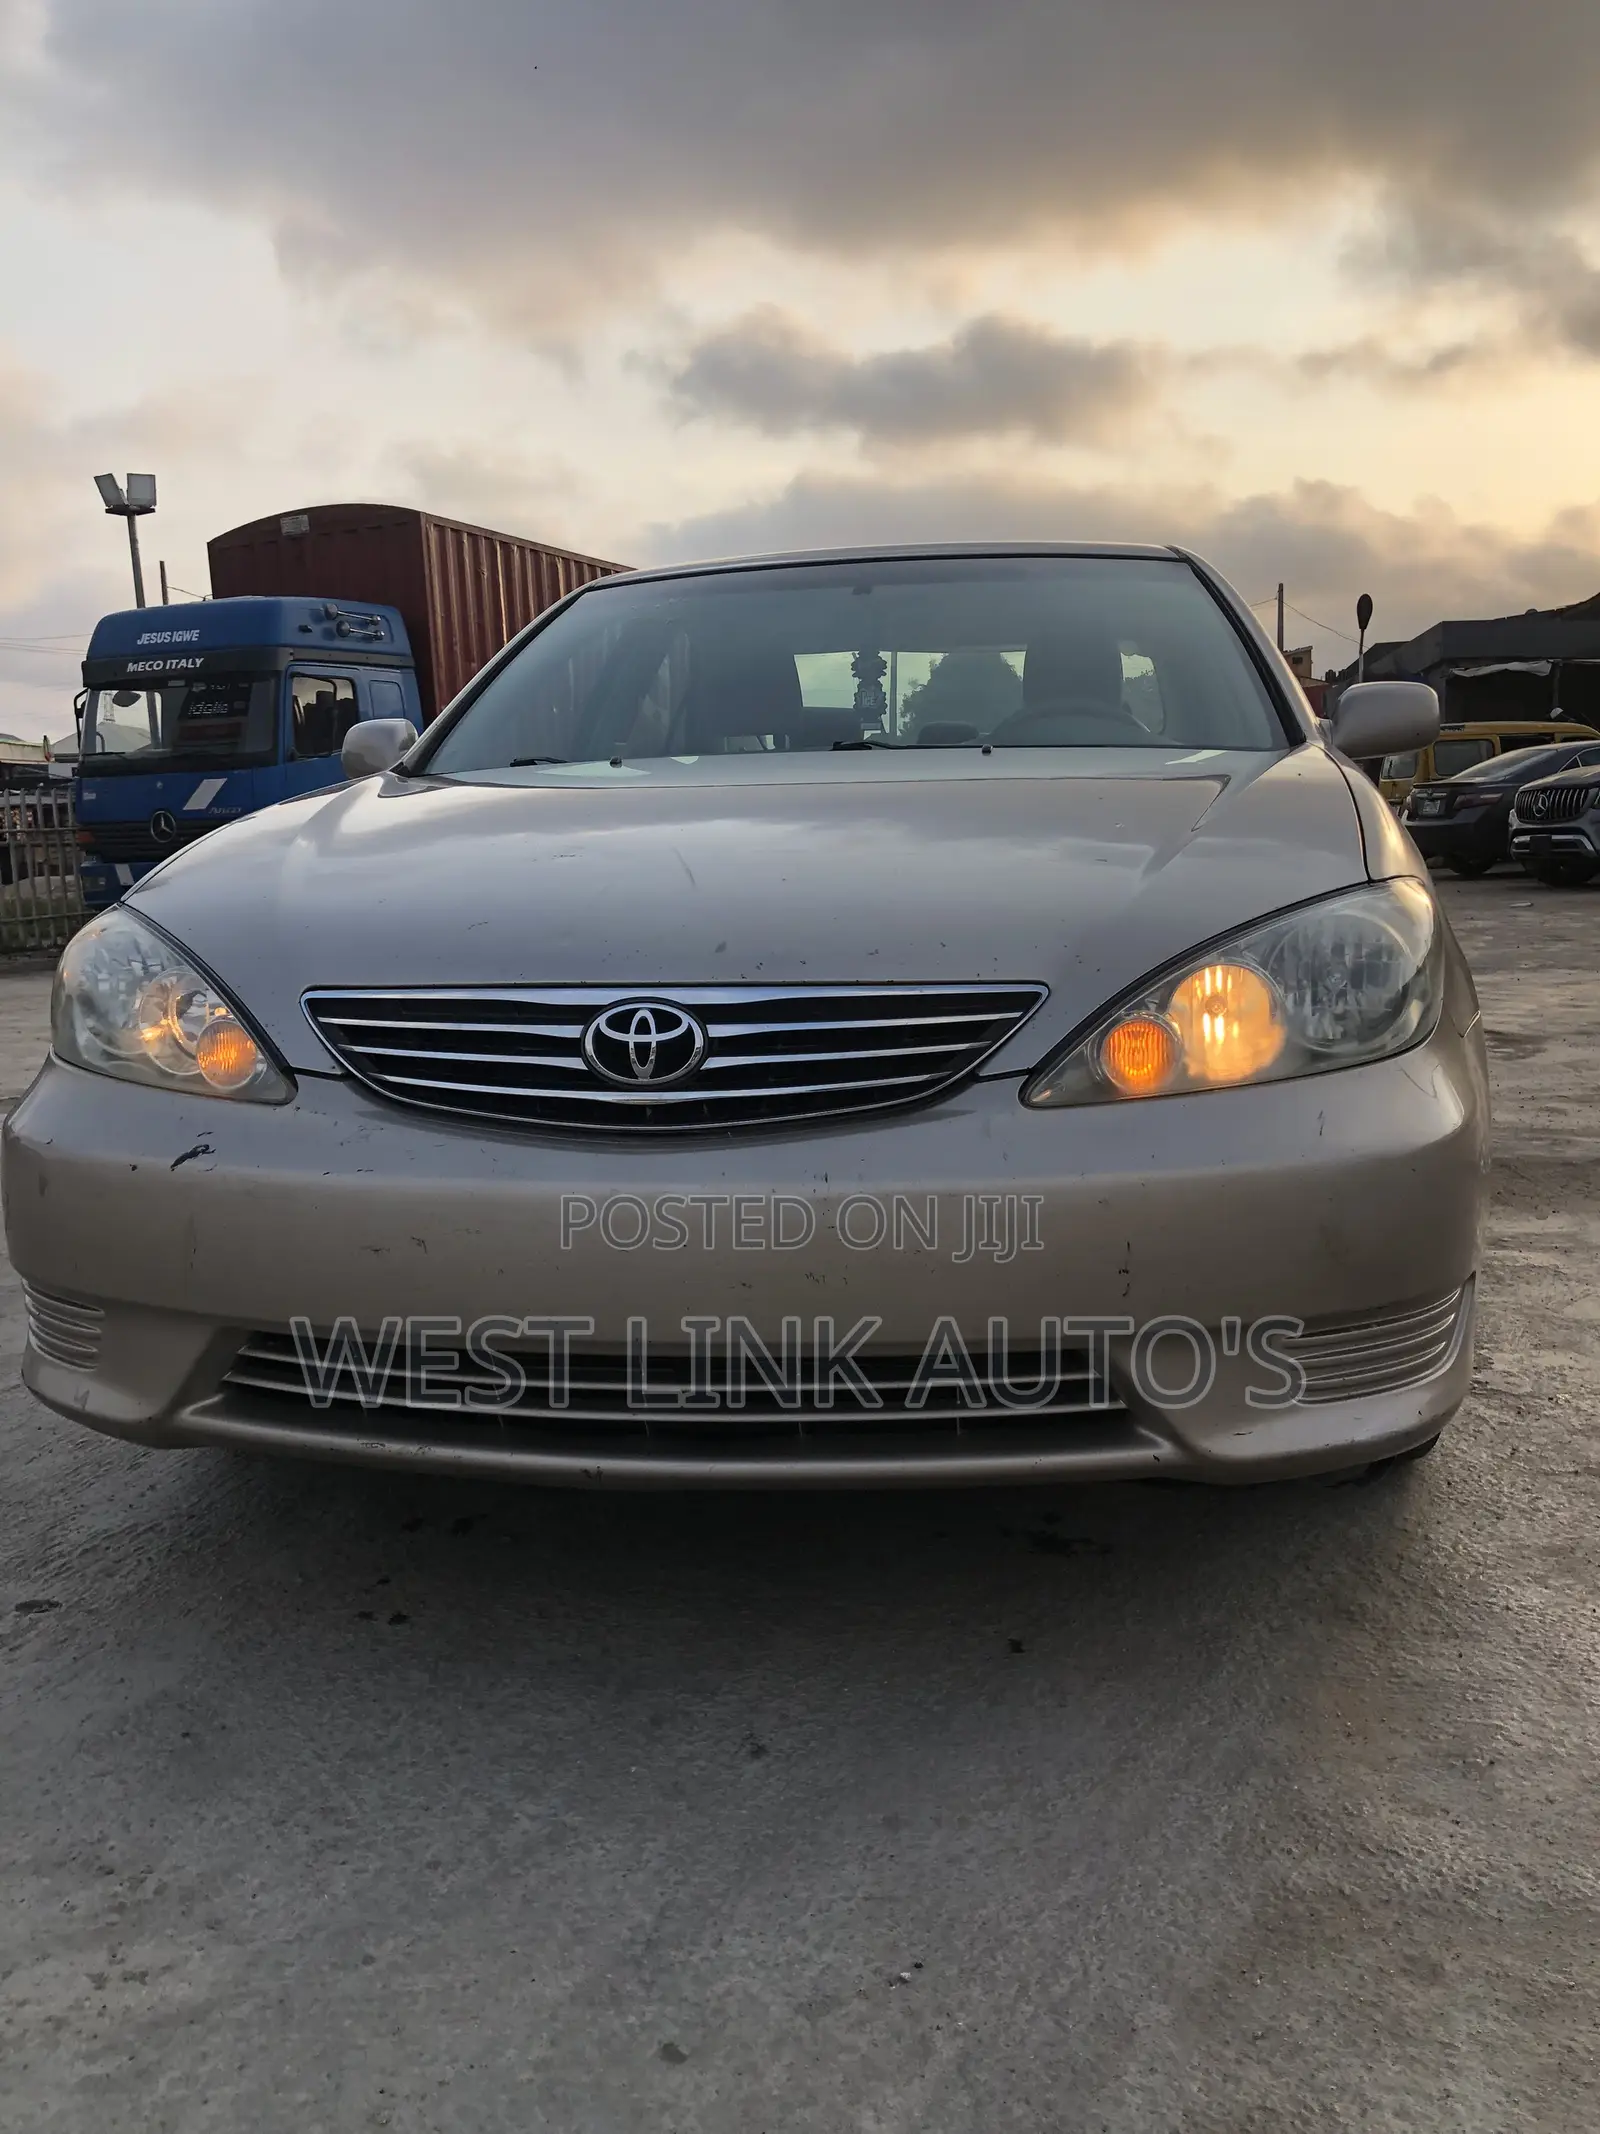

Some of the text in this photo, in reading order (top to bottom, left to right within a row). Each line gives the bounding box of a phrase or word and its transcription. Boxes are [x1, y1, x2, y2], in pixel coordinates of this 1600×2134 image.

[137, 629, 200, 645] JESUS IGWE
[126, 657, 205, 673] MECO ITALY
